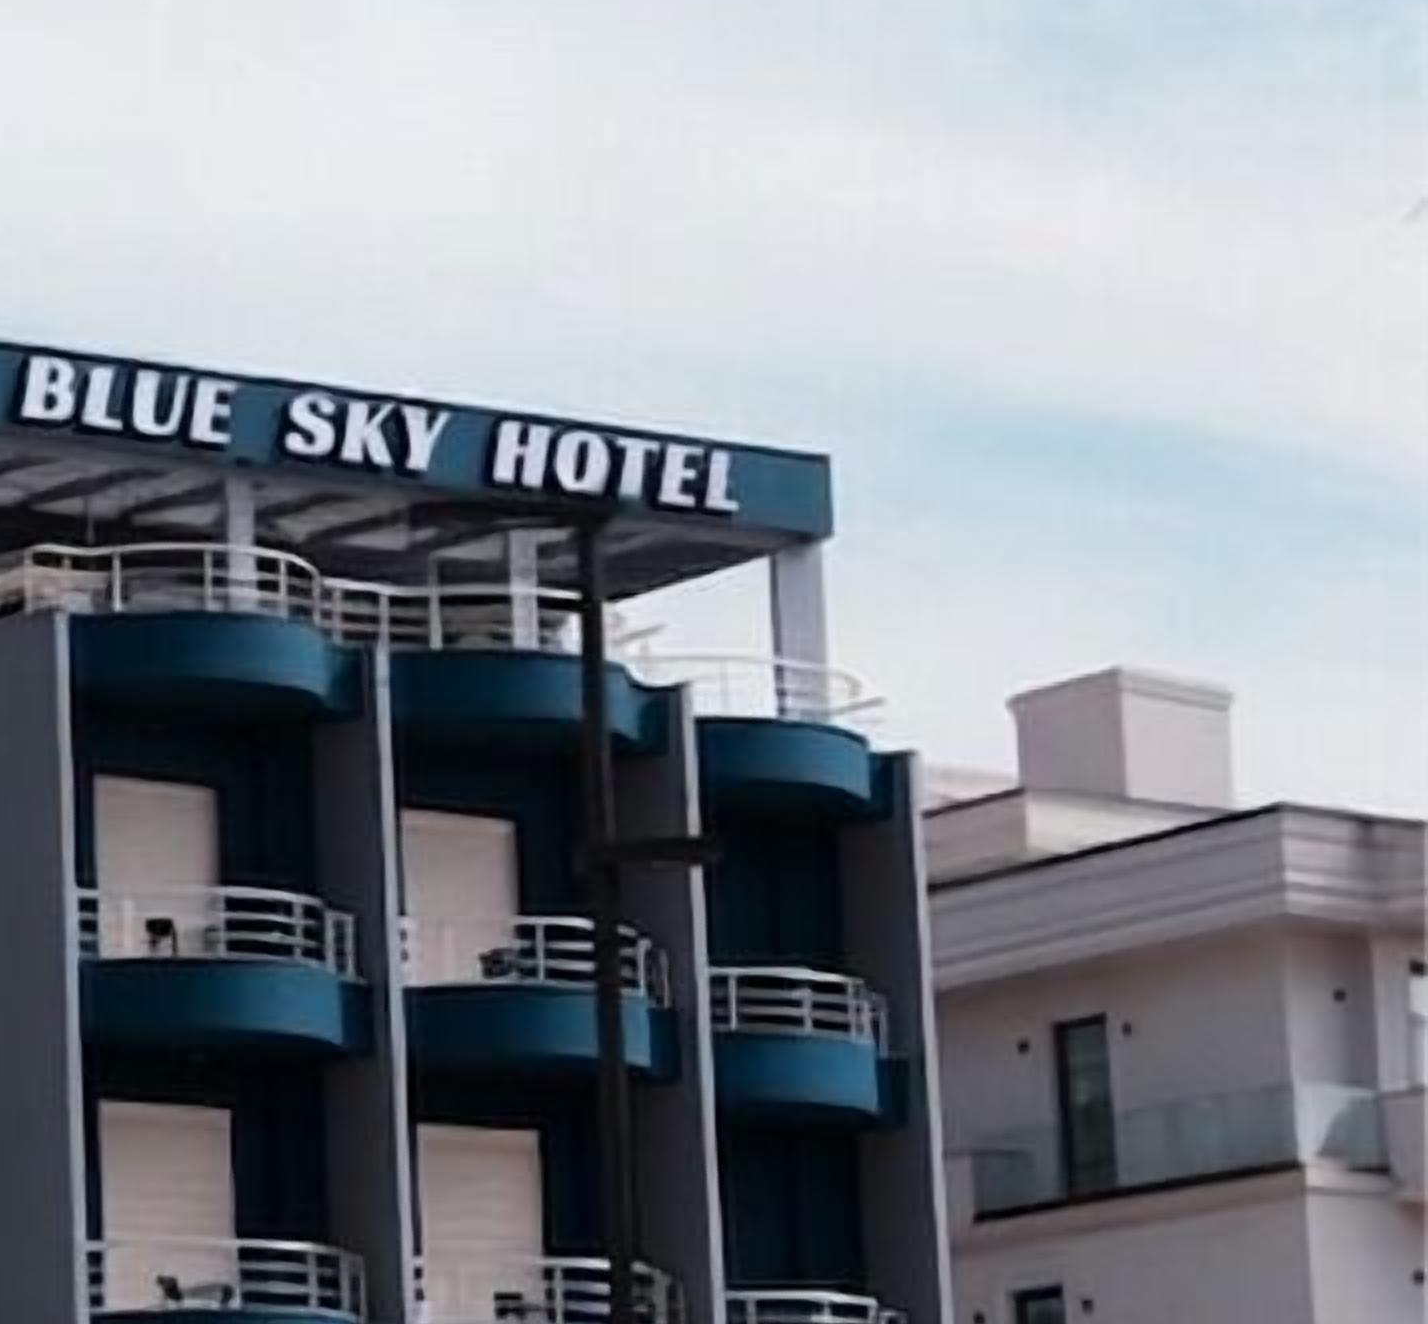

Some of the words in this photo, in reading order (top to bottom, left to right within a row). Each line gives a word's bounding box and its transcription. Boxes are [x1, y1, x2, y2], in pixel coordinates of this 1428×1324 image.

[21, 355, 240, 446] BLUE
[284, 390, 450, 472] SKY
[492, 422, 740, 513] HOTEL
